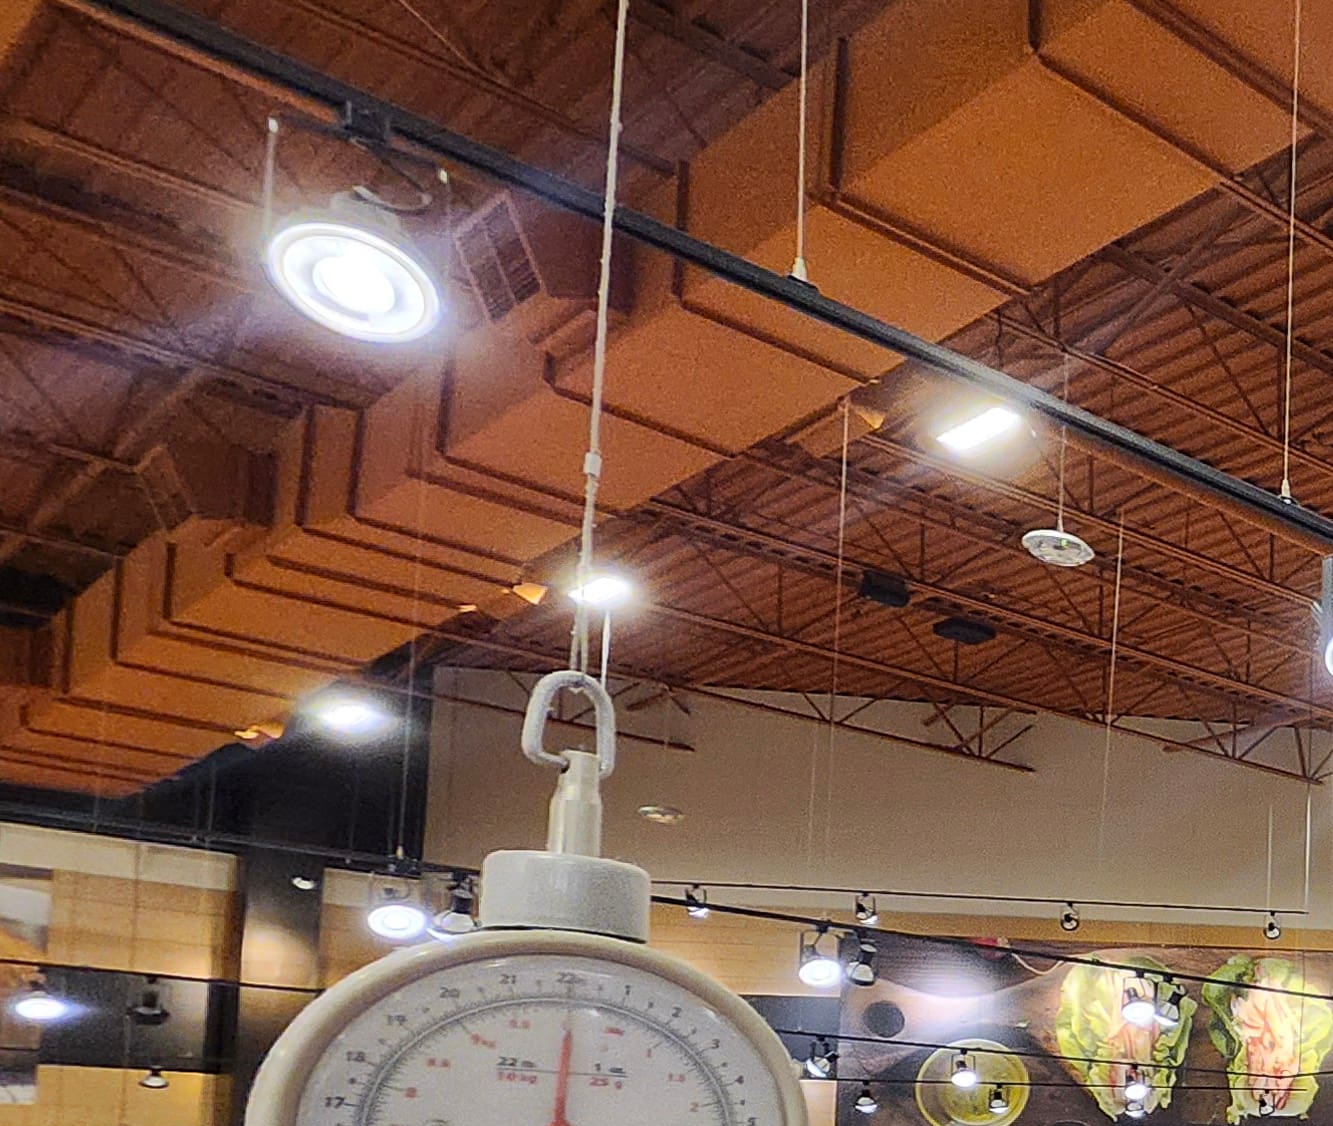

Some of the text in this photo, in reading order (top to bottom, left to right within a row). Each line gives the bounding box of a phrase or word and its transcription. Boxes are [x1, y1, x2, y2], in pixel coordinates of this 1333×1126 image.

[500, 974, 516, 985] 21
[439, 987, 460, 998] 20
[671, 1007, 682, 1018] 2
[387, 1014, 406, 1026] 19
[711, 1038, 721, 1049] 3
[346, 1051, 365, 1063] 18
[497, 1056, 518, 1067] 22
[324, 1096, 344, 1109] 17
